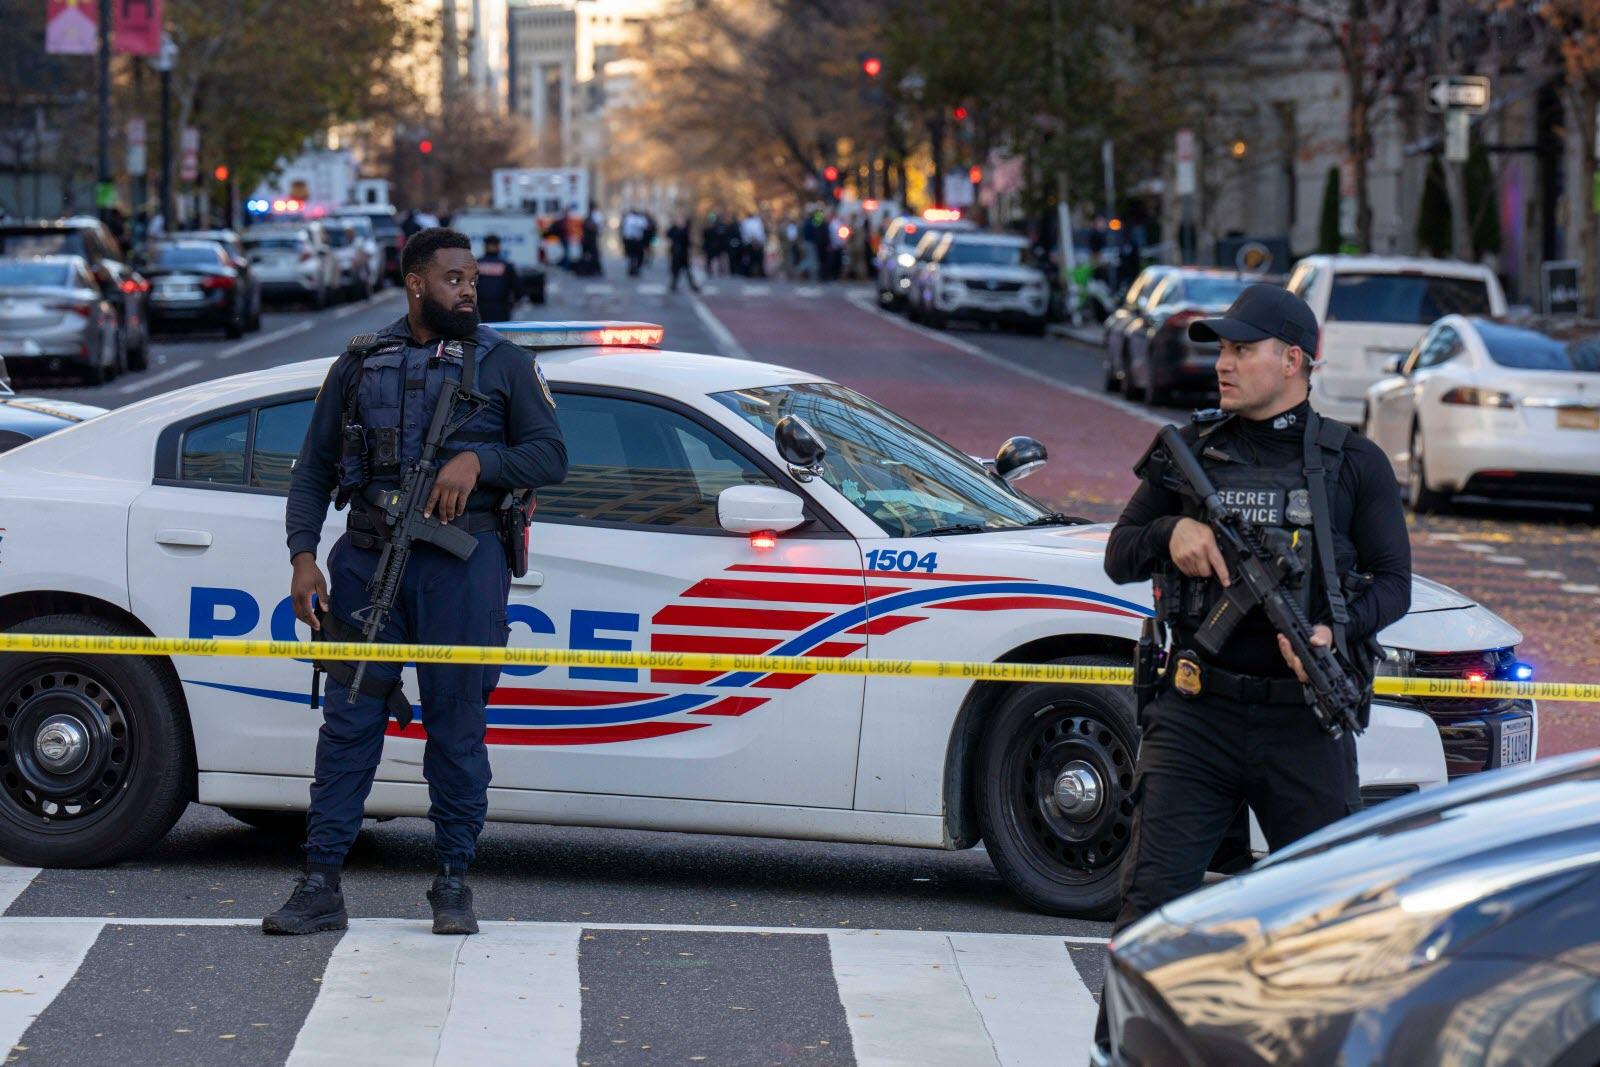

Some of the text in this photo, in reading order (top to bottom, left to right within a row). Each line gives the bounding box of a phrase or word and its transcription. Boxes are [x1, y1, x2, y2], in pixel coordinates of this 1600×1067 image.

[1217, 491, 1277, 506] SECRET
[1226, 507, 1279, 523] VICE
[865, 549, 938, 573] 1504
[189, 586, 640, 684] PCE
